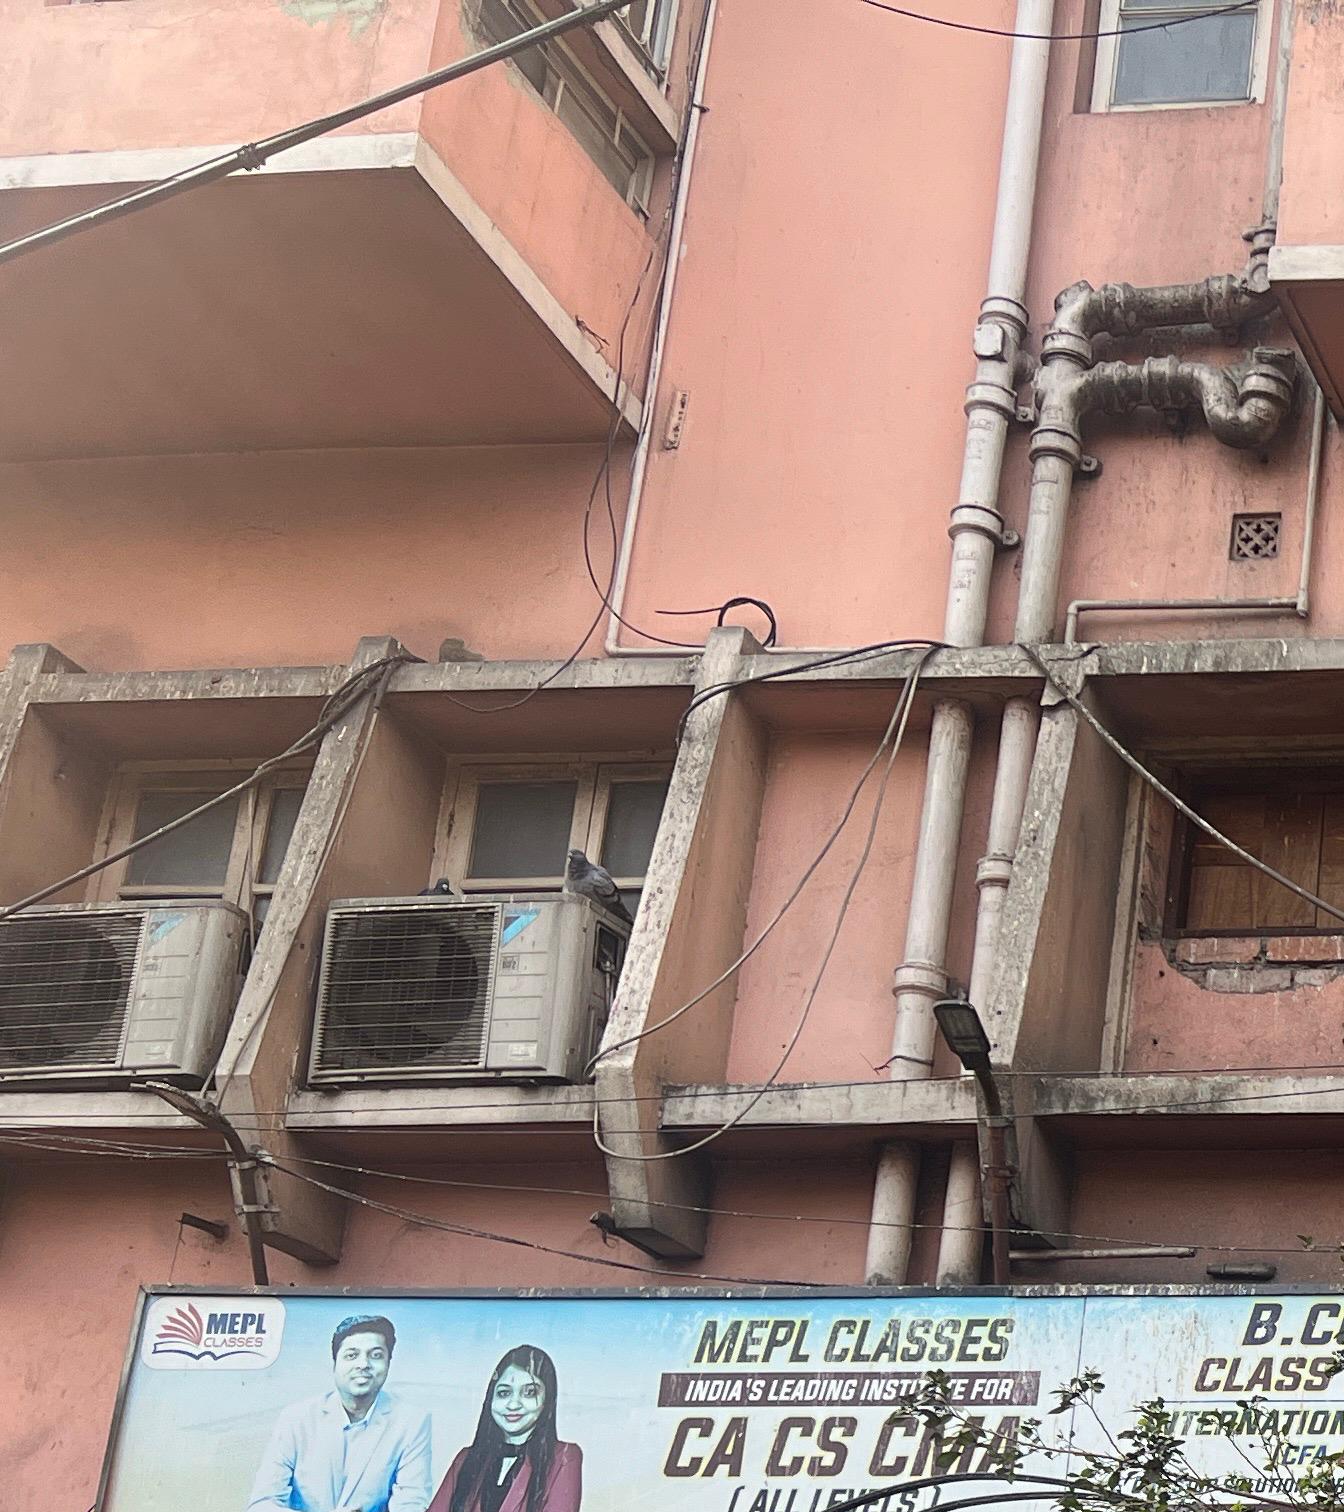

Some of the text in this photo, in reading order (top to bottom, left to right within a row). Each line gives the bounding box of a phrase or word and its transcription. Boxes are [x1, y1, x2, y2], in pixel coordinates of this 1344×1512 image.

[205, 1312, 267, 1335] MEPL
[203, 1335, 264, 1349] CLASSES
[694, 1317, 1016, 1365] MEPL CLASSES
[1194, 1356, 1336, 1392] CLASS
[684, 1378, 763, 1402] INDIA'S
[767, 1378, 856, 1402] LEADING
[970, 1377, 1015, 1401] FOR
[662, 1414, 1023, 1479] CA CS CMA
